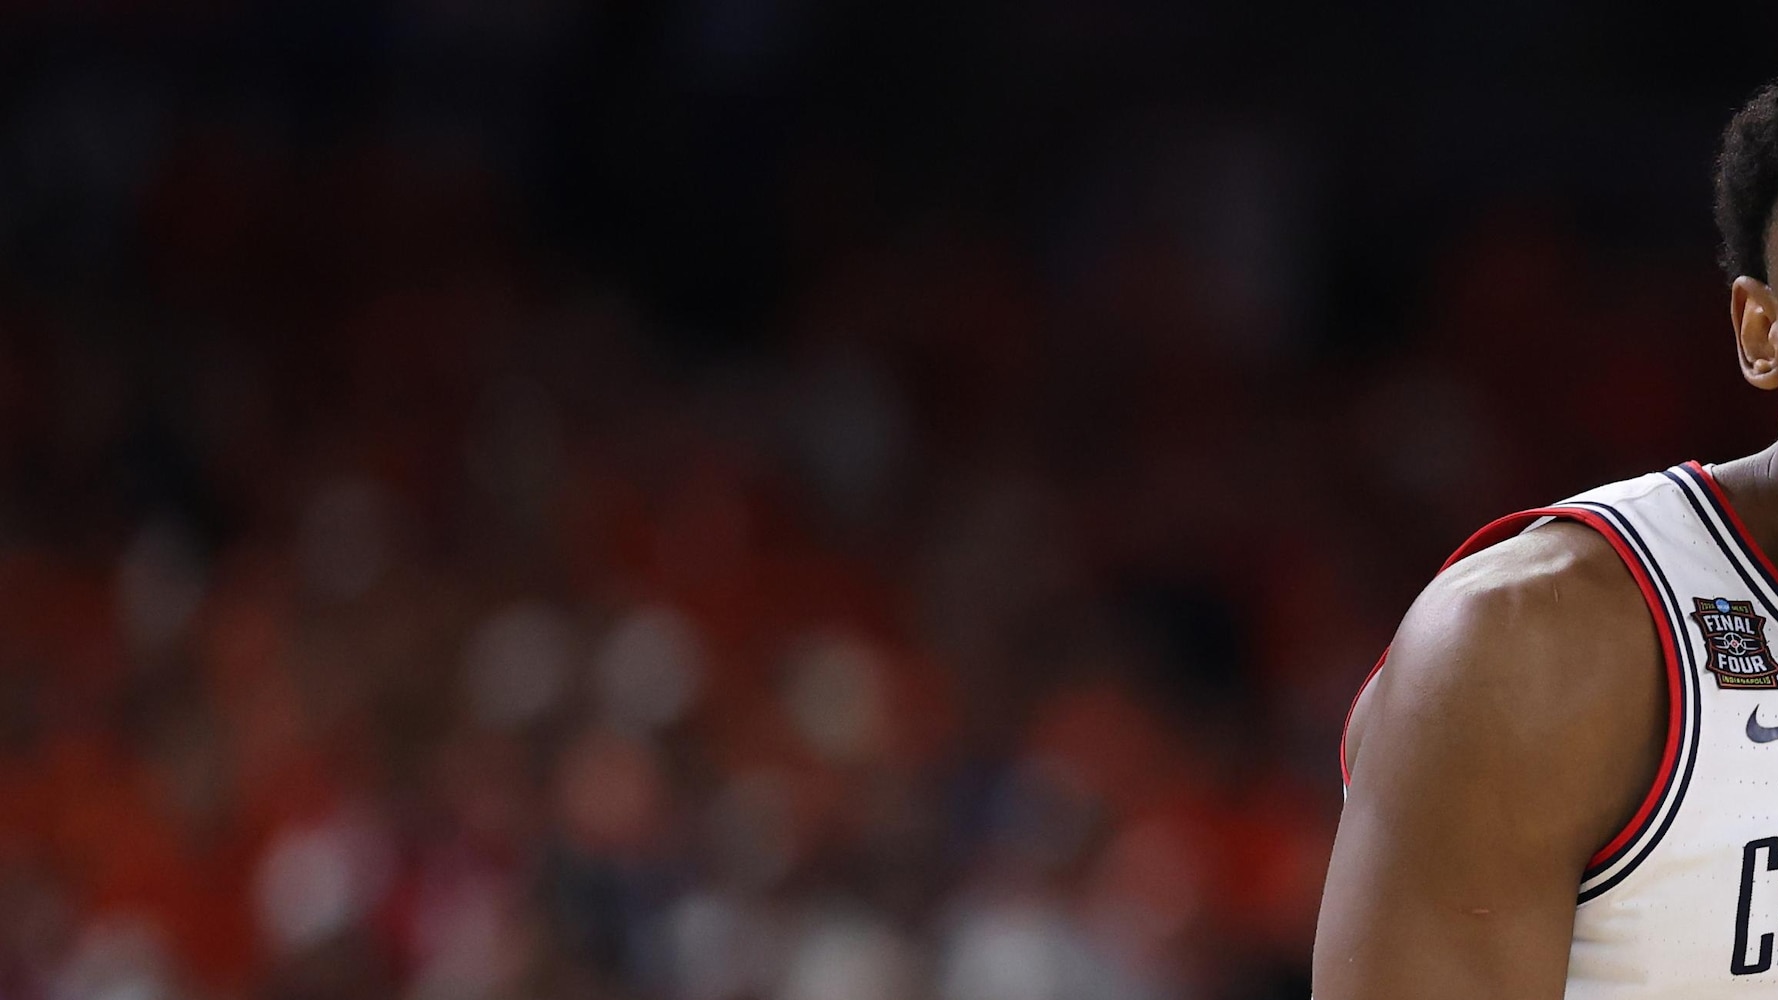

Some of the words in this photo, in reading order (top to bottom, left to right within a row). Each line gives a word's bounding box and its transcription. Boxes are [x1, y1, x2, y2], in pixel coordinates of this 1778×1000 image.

[1704, 614, 1755, 635] FINAL
[1717, 653, 1767, 674] FOUR
[1721, 675, 1771, 685] INDIANAPOLIS
